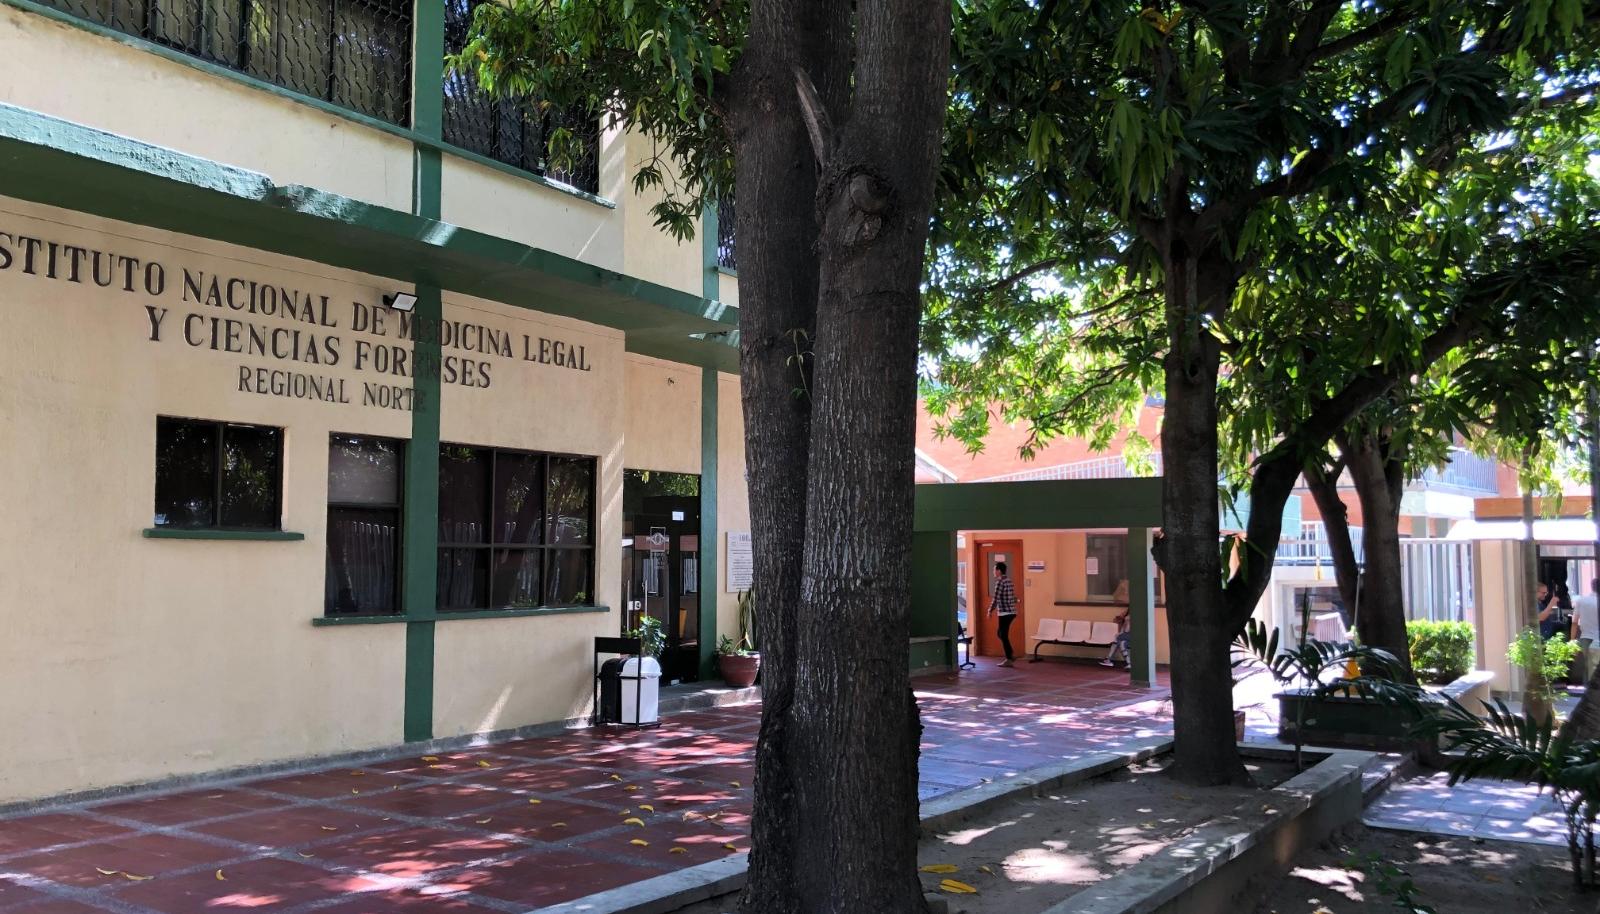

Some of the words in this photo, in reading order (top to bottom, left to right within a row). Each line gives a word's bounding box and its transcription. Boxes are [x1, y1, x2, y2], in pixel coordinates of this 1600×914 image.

[145, 305, 168, 342] Y
[182, 312, 340, 366] CIENCIAS
[182, 267, 337, 328] NACIONAL
[352, 301, 387, 337] DE
[522, 334, 592, 372] LEGAL
[237, 365, 349, 404] REGIONAL
